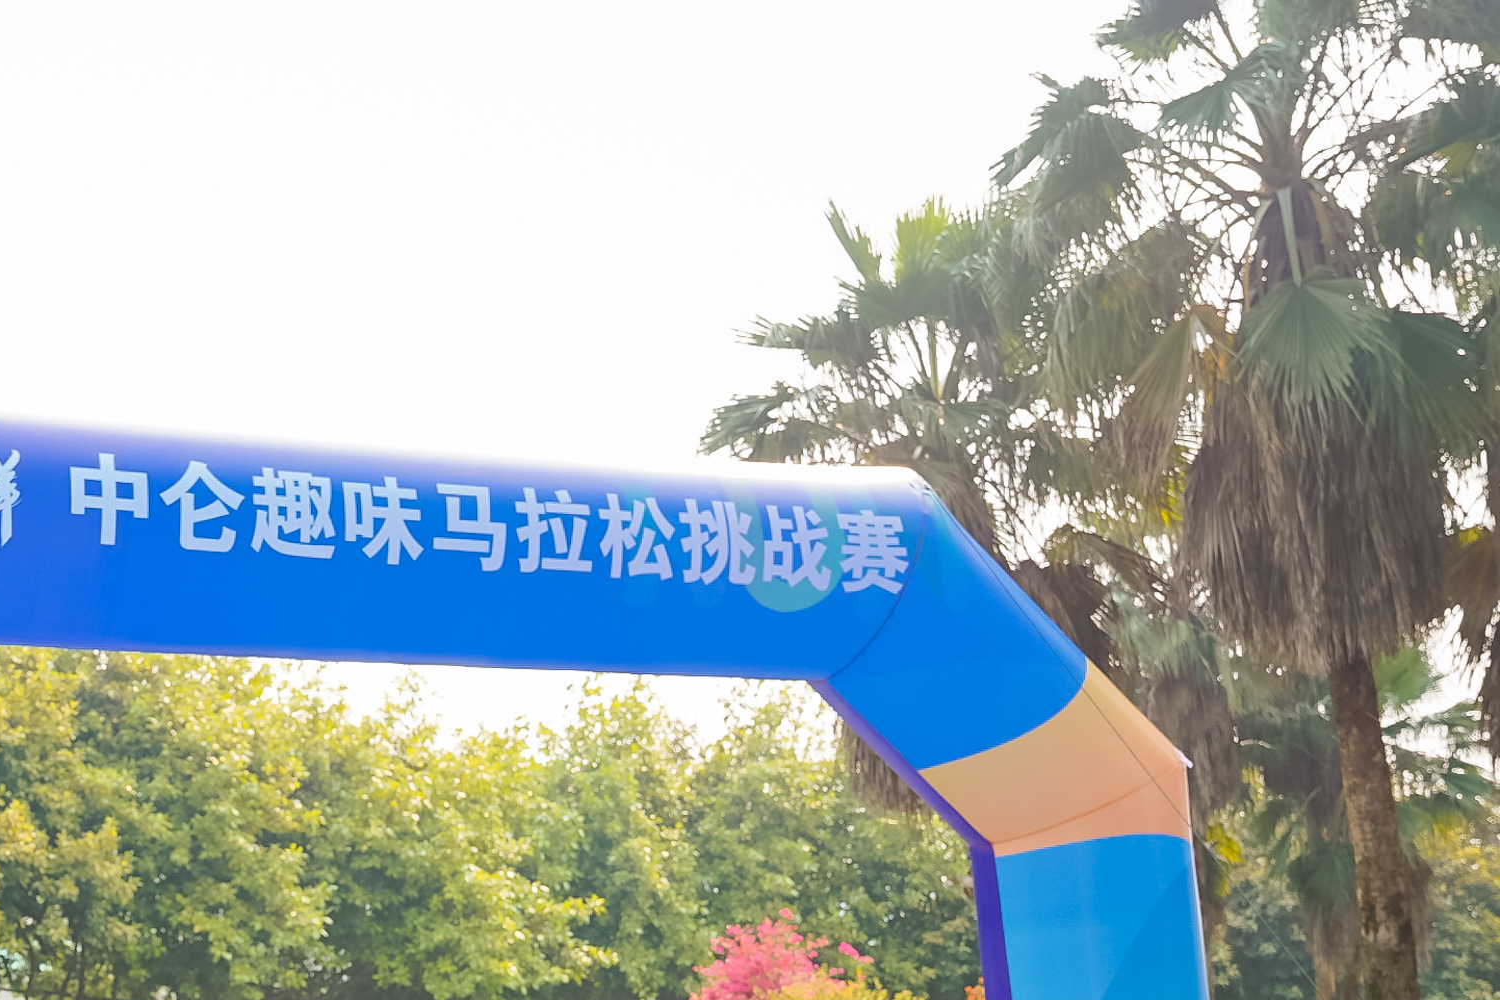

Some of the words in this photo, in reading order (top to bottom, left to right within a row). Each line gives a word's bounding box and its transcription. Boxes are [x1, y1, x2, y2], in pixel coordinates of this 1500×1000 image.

[69, 453, 910, 596] 中仑趣味马拉松挑战赛
